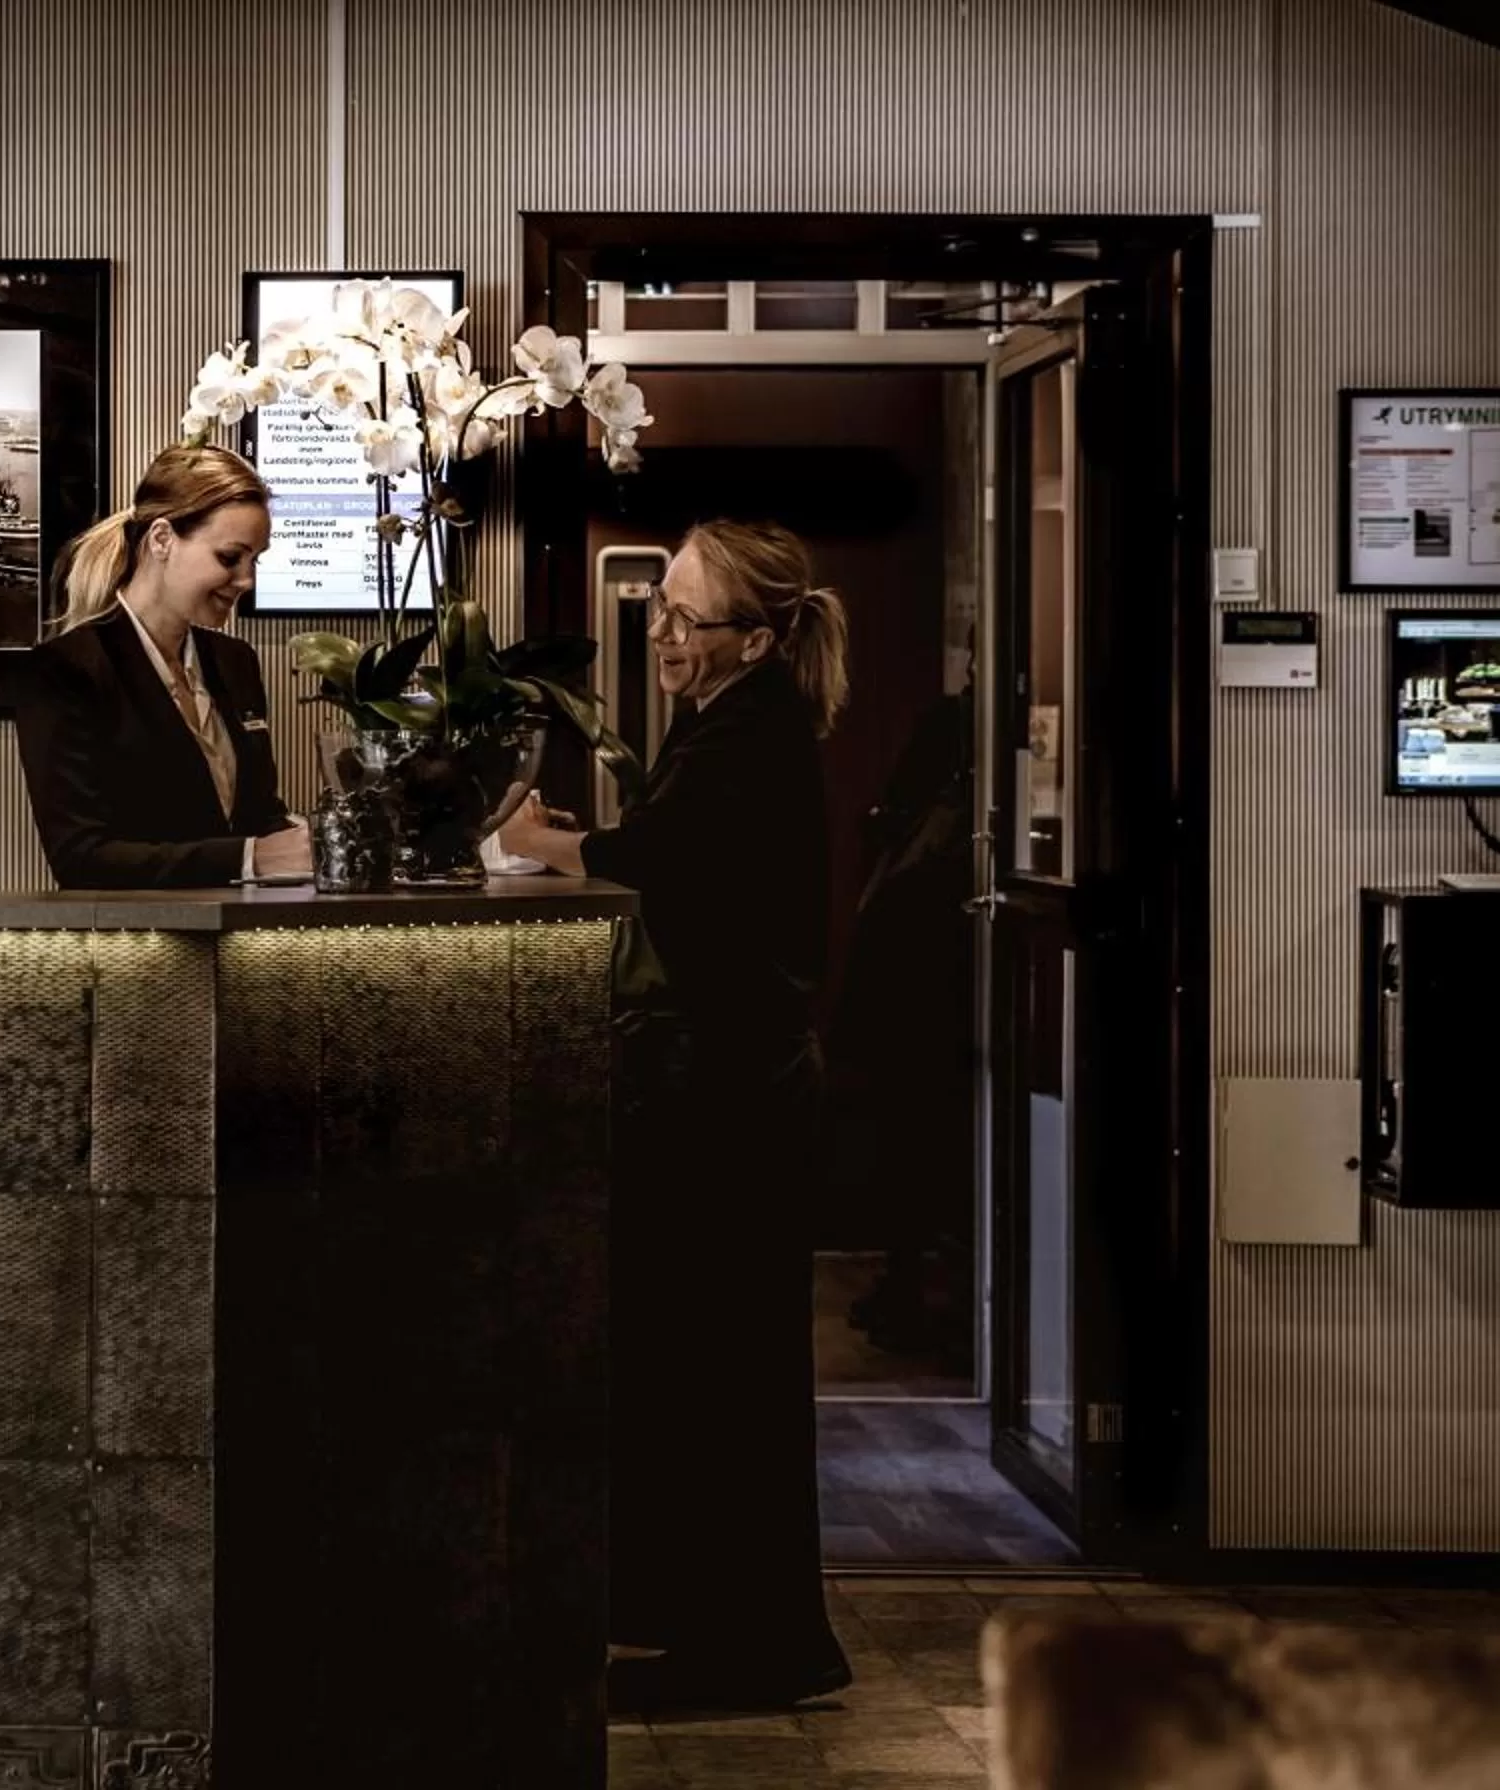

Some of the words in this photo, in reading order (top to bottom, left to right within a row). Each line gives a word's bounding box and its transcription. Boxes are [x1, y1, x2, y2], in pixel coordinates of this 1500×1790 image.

[1400, 407, 1500, 425] UTRYMNI
[268, 530, 329, 539] crumMaster
[289, 557, 329, 567] Vinnova
